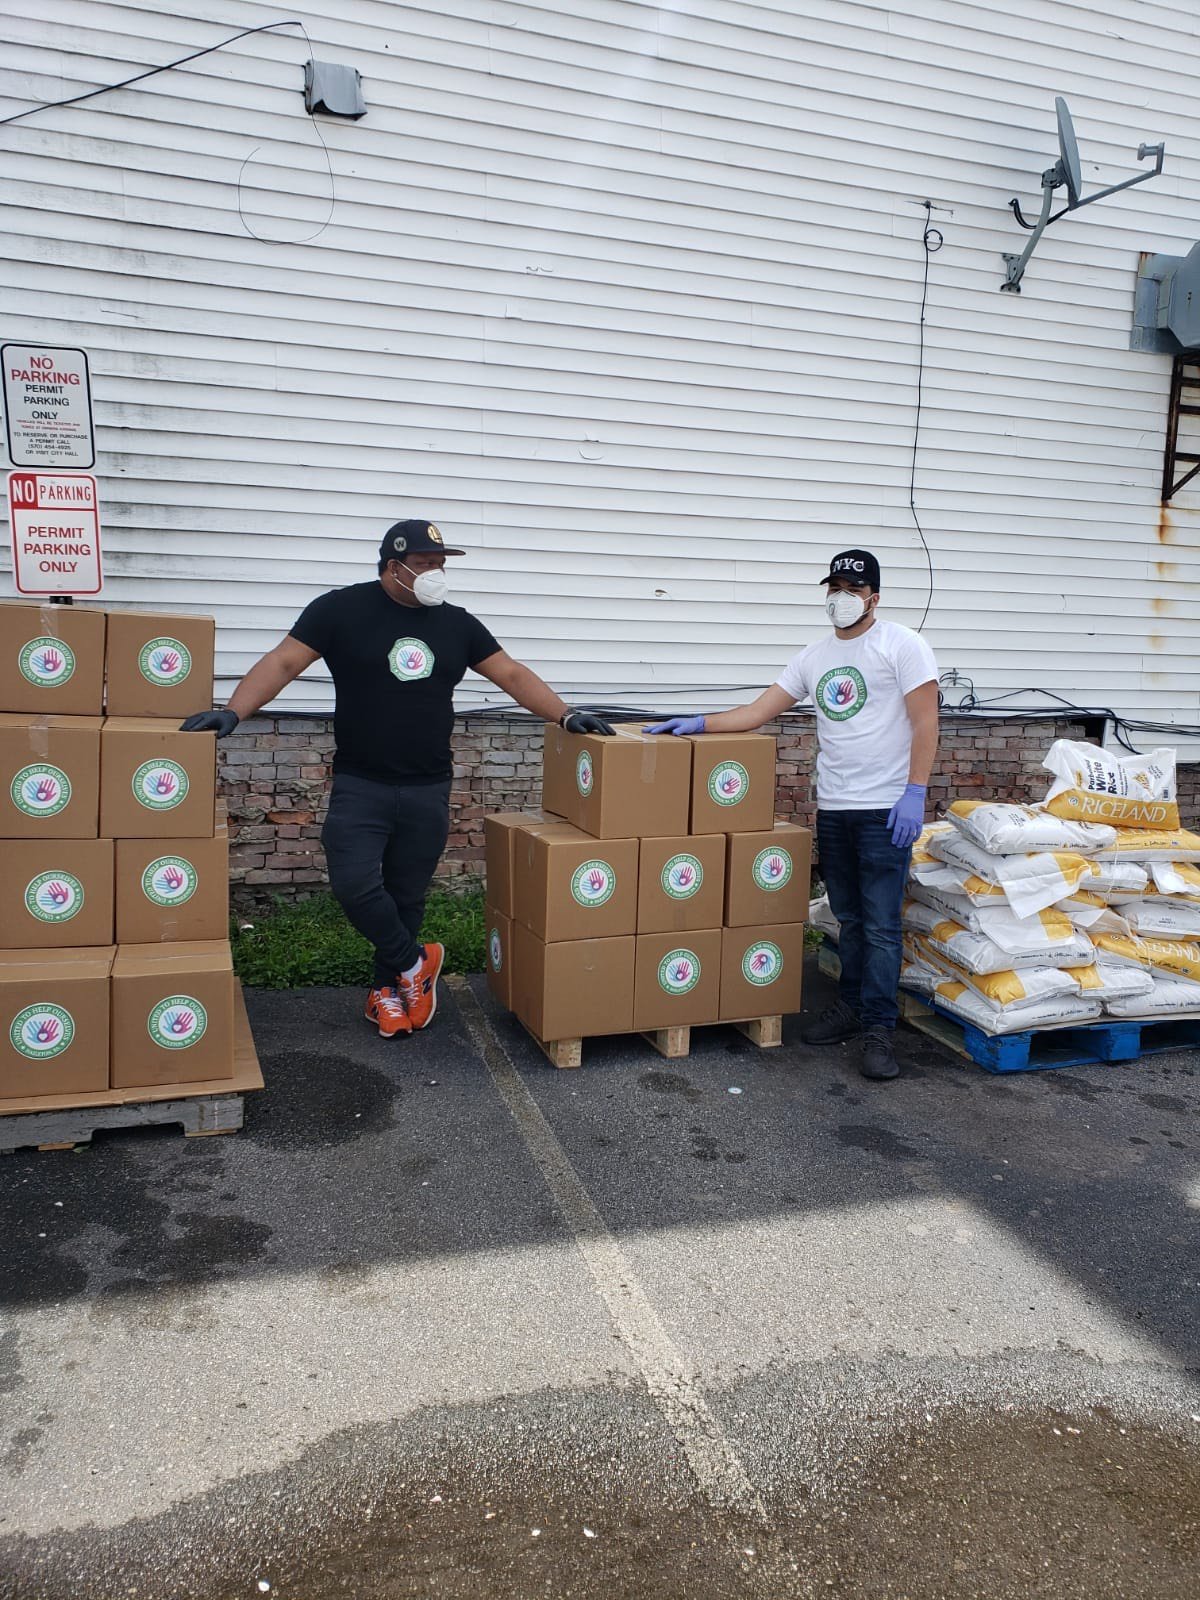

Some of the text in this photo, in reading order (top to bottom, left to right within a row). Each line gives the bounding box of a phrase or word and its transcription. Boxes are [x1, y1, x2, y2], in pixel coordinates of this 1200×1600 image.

[30, 356, 53, 369] NO
[11, 368, 80, 385] PARKING
[25, 384, 64, 394] PERMIT
[24, 396, 69, 406] PARKING
[32, 410, 58, 420] ONLY
[12, 479, 91, 503] NO PARKING
[28, 526, 84, 538] PERMIT
[23, 543, 91, 556] PARKING
[394, 540, 405, 549] W
[39, 560, 78, 573] ONLY
[832, 557, 865, 573] NYC
[1094, 761, 1106, 791] White
[1107, 772, 1118, 795] Rice
[1080, 796, 1167, 823] RICELAND
